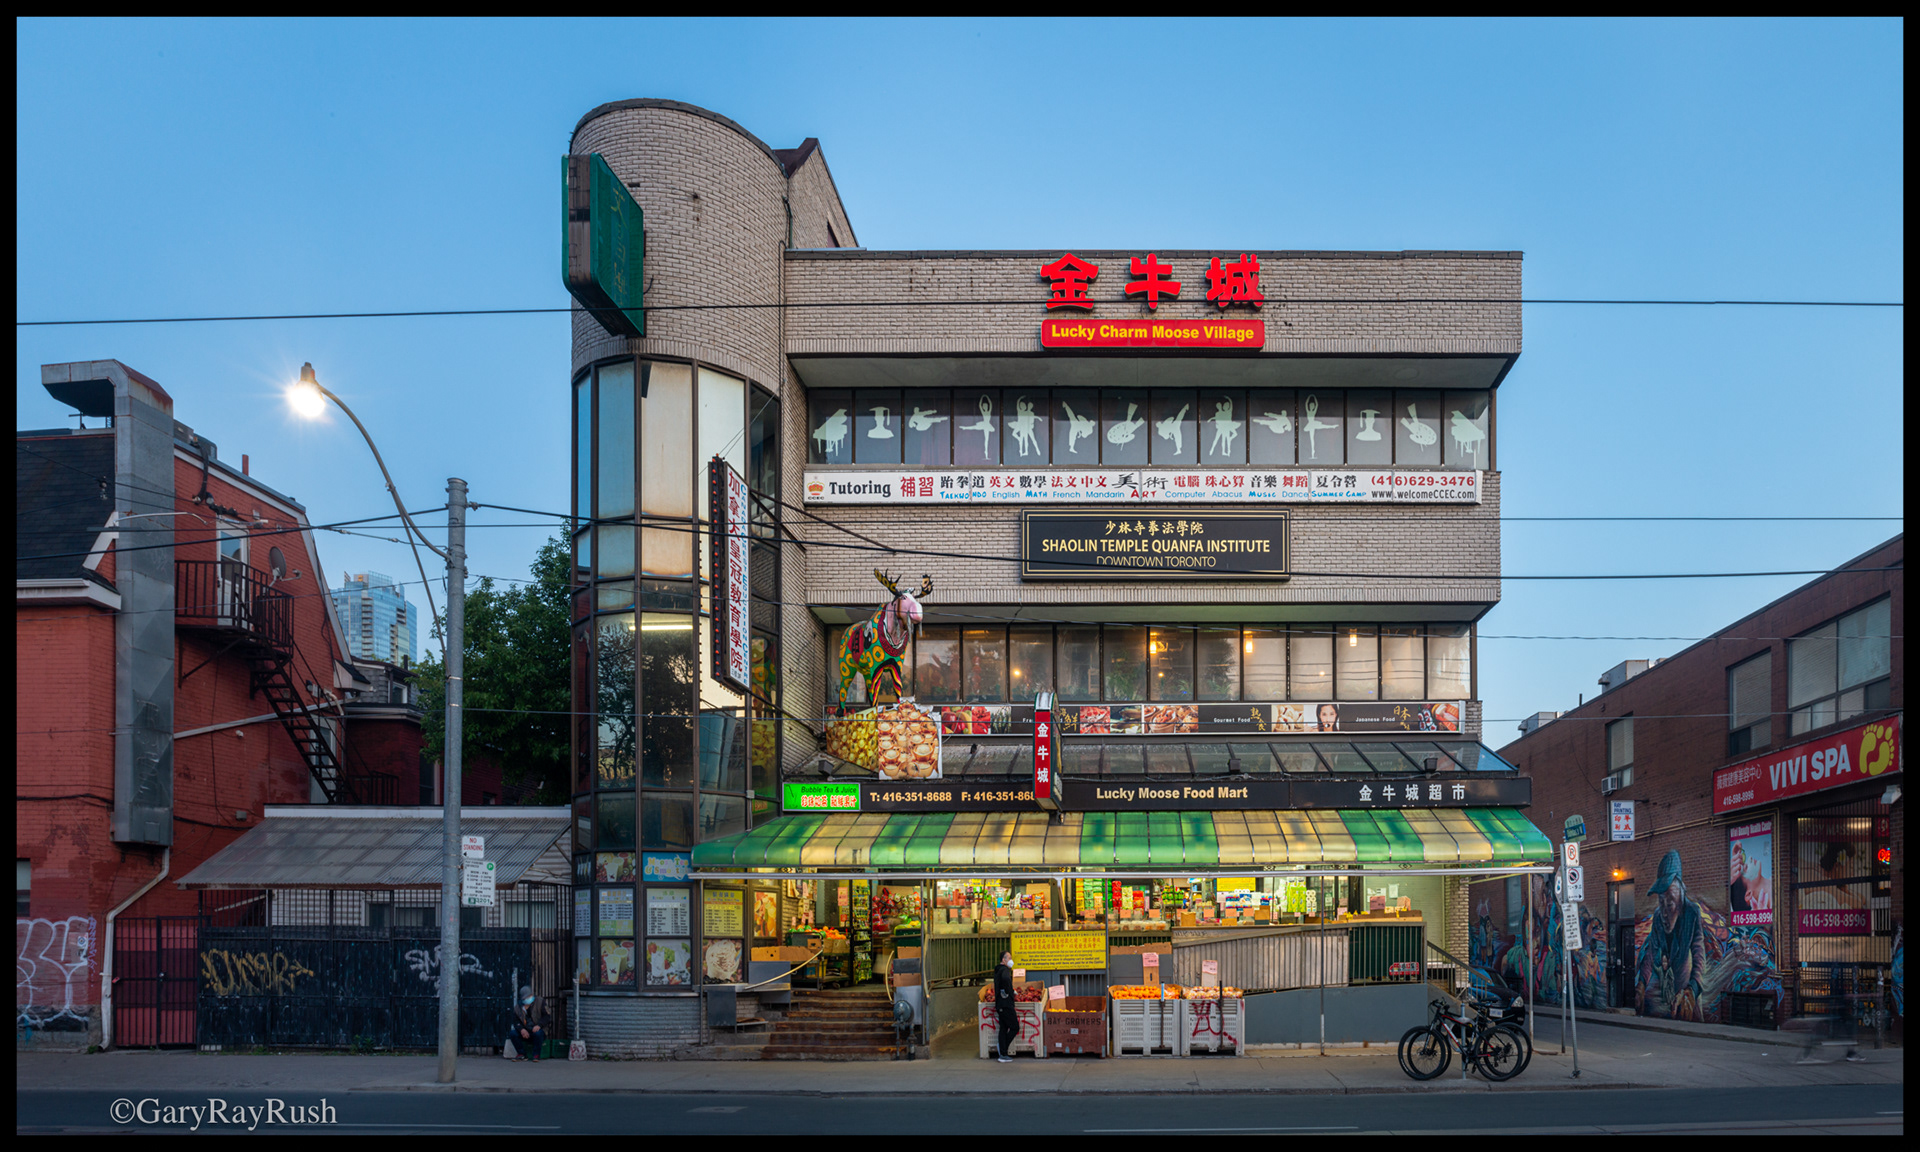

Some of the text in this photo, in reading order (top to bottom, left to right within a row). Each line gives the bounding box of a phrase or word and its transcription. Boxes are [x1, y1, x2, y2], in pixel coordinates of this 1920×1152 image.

[1040, 252, 1265, 310] 金牛城
[1051, 324, 1254, 342] Lucky Charm Moose Village
[900, 476, 934, 498] 補習
[989, 475, 1015, 488] 英文
[1019, 475, 1047, 489] 數學
[1051, 475, 1077, 488] 法文
[1081, 475, 1107, 488] 中文
[1173, 475, 1200, 488] 電腦
[1205, 475, 1244, 488] 珠心算
[1250, 474, 1277, 488] 音樂
[1316, 474, 1357, 488] 夏令營
[1371, 475, 1475, 487] (416)629-3476
[829, 480, 892, 498] Tutoring
[992, 490, 1020, 499] English
[1025, 490, 1048, 498] MATH
[1052, 490, 1080, 498] French
[1085, 490, 1125, 498] Mandarin
[1130, 488, 1157, 498] ART
[1165, 490, 1206, 499] Computer
[1212, 490, 1243, 498] Abacus
[1282, 490, 1309, 498] Dance
[1311, 490, 1344, 498] SUMMER
[1371, 489, 1475, 499] www.welcomeCCEC.com
[1104, 520, 1204, 537] 少林寺拳法學院
[1042, 538, 1270, 553] SHAOLIN TEMPLE QUANFA INSTITUTE
[1096, 555, 1217, 568] DOWNTOWN TORONTO
[1037, 722, 1049, 783] 金牛城
[1769, 744, 1852, 791] VIVI SPA
[869, 791, 952, 802] T: 416-351-8688
[961, 791, 971, 801] F:
[1096, 786, 1248, 801] Lucky Moose Food Mart
[1359, 783, 1466, 802] 金牛城超市
[1802, 913, 1866, 927] 416-598-8996
